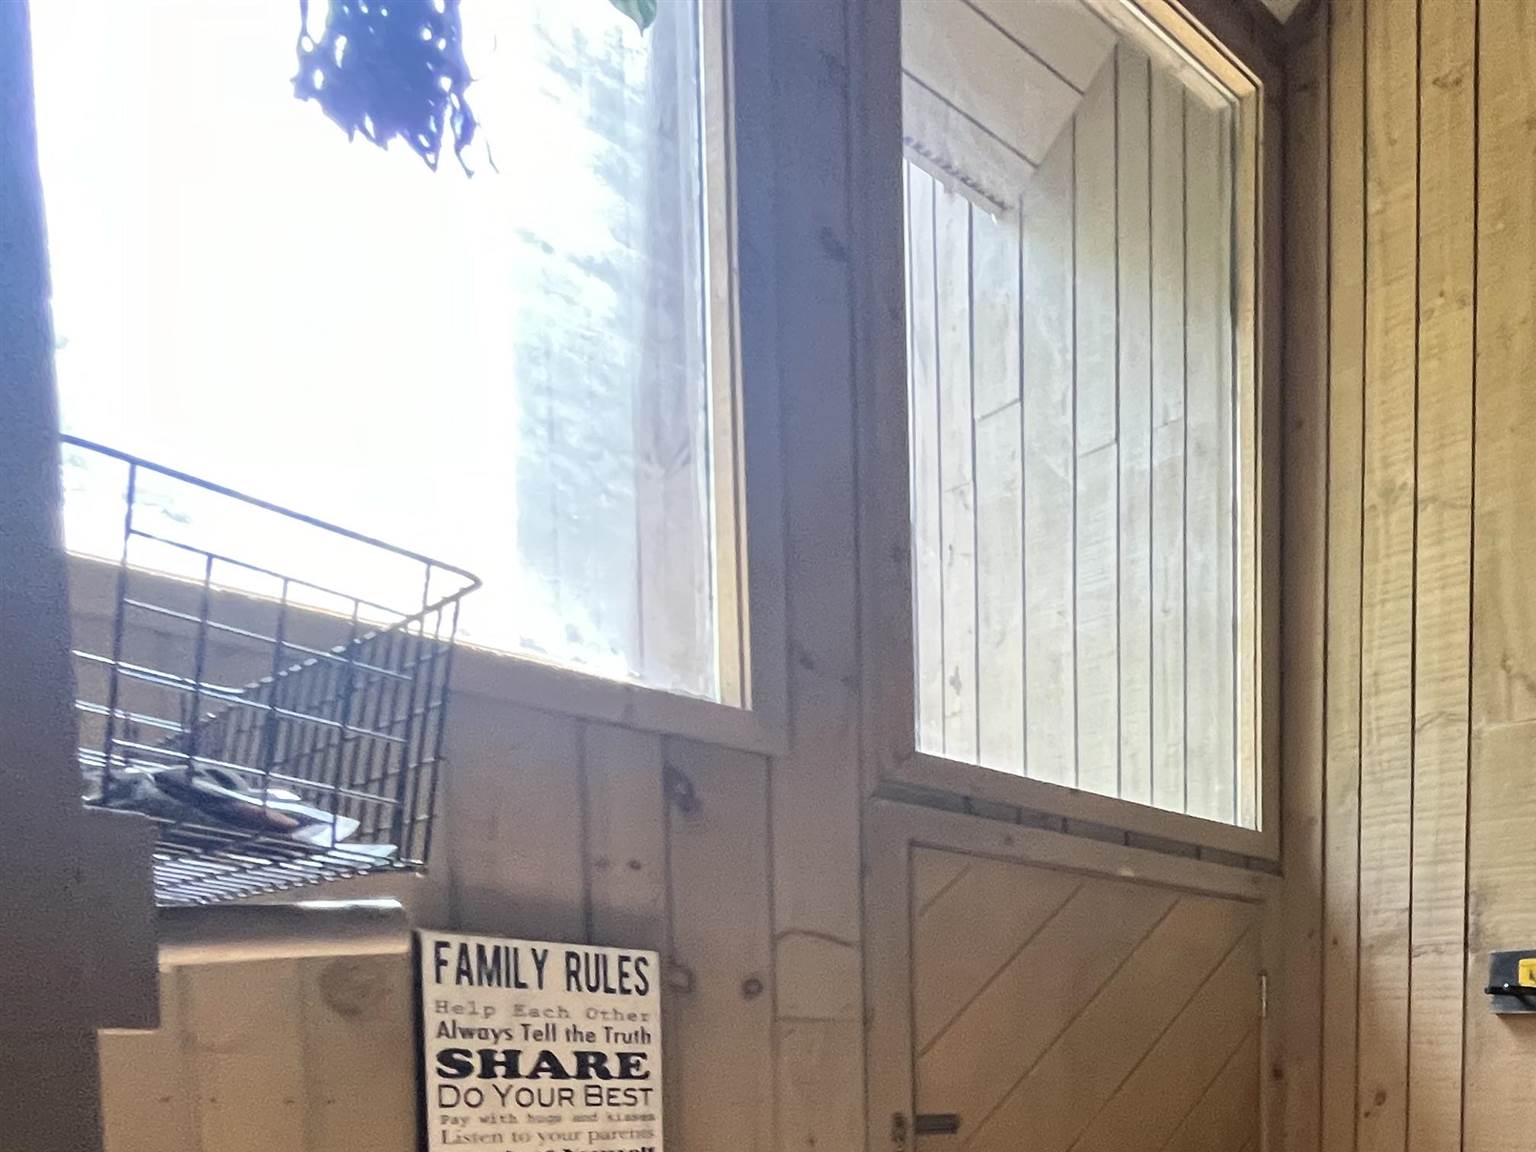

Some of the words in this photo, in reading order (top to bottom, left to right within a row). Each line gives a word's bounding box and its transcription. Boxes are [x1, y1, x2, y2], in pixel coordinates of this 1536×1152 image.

[434, 941, 549, 990] FAMILY
[565, 951, 649, 996] RULES
[434, 1000, 496, 1019] Help
[514, 1003, 570, 1019] Each
[586, 1006, 650, 1022] Other
[436, 1020, 513, 1044] Always
[521, 1023, 556, 1043] Tell
[565, 1025, 596, 1043] the
[604, 1026, 651, 1044] Truth
[436, 1048, 650, 1080] SHARE
[438, 1084, 484, 1108] DO
[492, 1084, 576, 1108] YOUR
[584, 1084, 653, 1107] BEST
[440, 1114, 469, 1128] Pay
[441, 1129, 503, 1145] Listen
[511, 1131, 531, 1142] to
[537, 1130, 581, 1146] your
